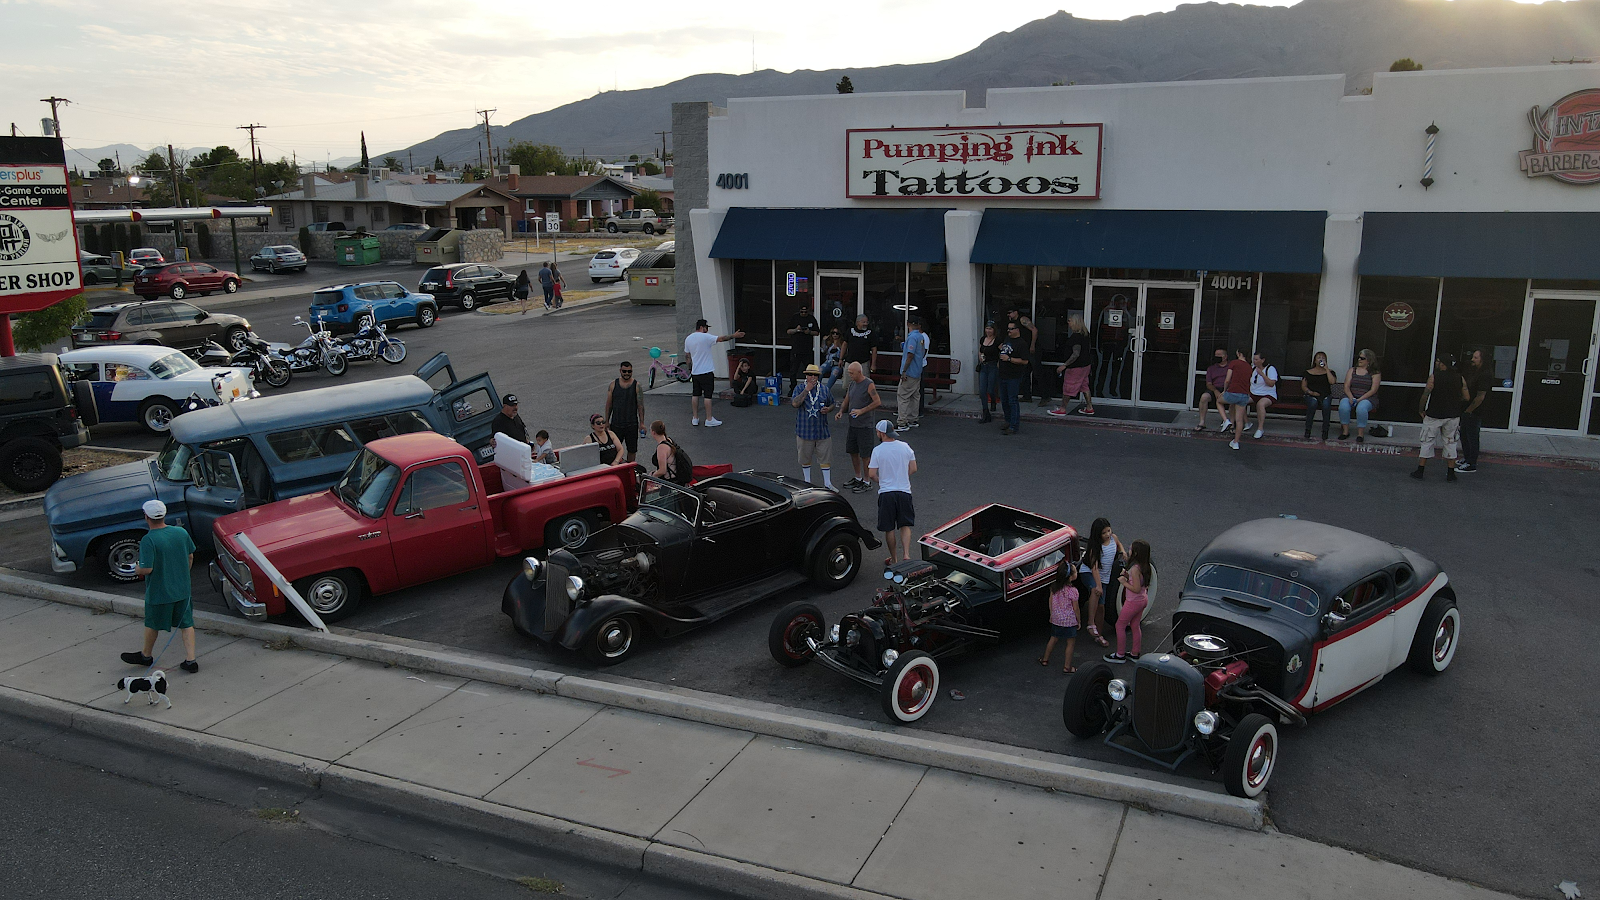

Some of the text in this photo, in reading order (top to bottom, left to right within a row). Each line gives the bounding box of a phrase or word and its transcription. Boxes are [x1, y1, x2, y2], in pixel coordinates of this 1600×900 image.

[863, 132, 1083, 166] Pumping Ink
[716, 173, 748, 189] 4001
[862, 167, 1081, 196] Tattoos
[34, 186, 67, 194] Console
[0, 196, 42, 205] Center
[548, 222, 559, 231] 30
[26, 271, 75, 288] SHOP
[1211, 275, 1252, 290] 4001-1
